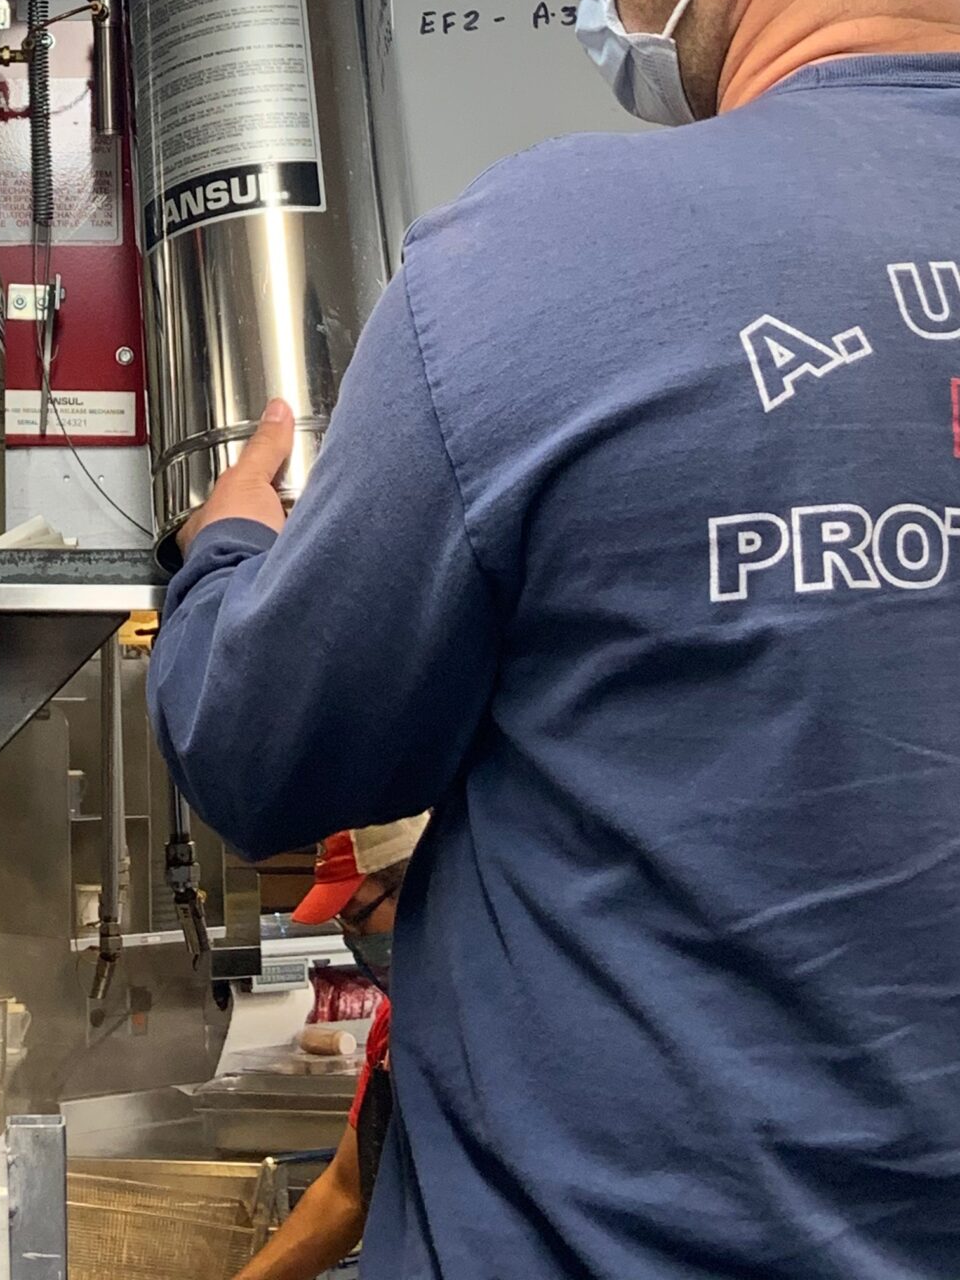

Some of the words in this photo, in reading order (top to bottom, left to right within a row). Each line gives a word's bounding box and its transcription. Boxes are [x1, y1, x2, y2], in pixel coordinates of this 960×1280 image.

[420, 10, 480, 35] EF2
[739, 313, 873, 413] A.
[708, 503, 960, 602] PRO
